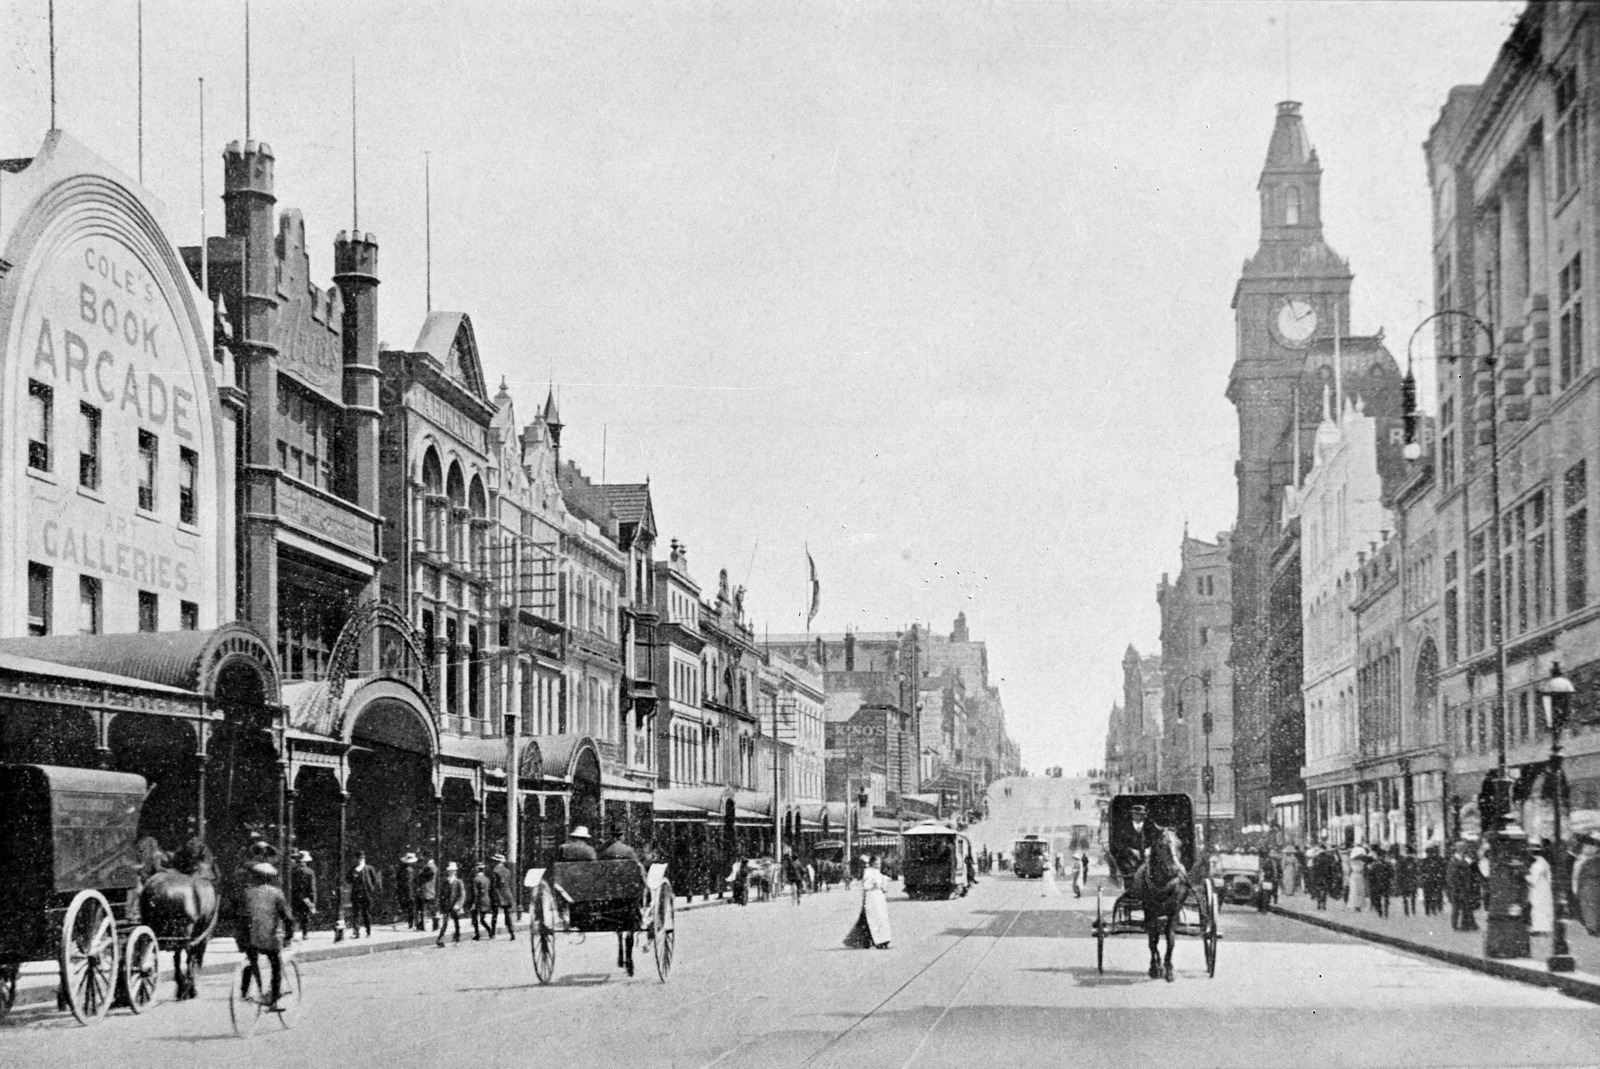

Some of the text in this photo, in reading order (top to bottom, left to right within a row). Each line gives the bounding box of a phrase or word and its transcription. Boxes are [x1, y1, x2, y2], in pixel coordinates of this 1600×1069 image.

[85, 248, 154, 302] COLE'S
[80, 282, 159, 358] BOOK
[34, 316, 193, 441] ARCADE
[43, 519, 189, 592] GALLERIES
